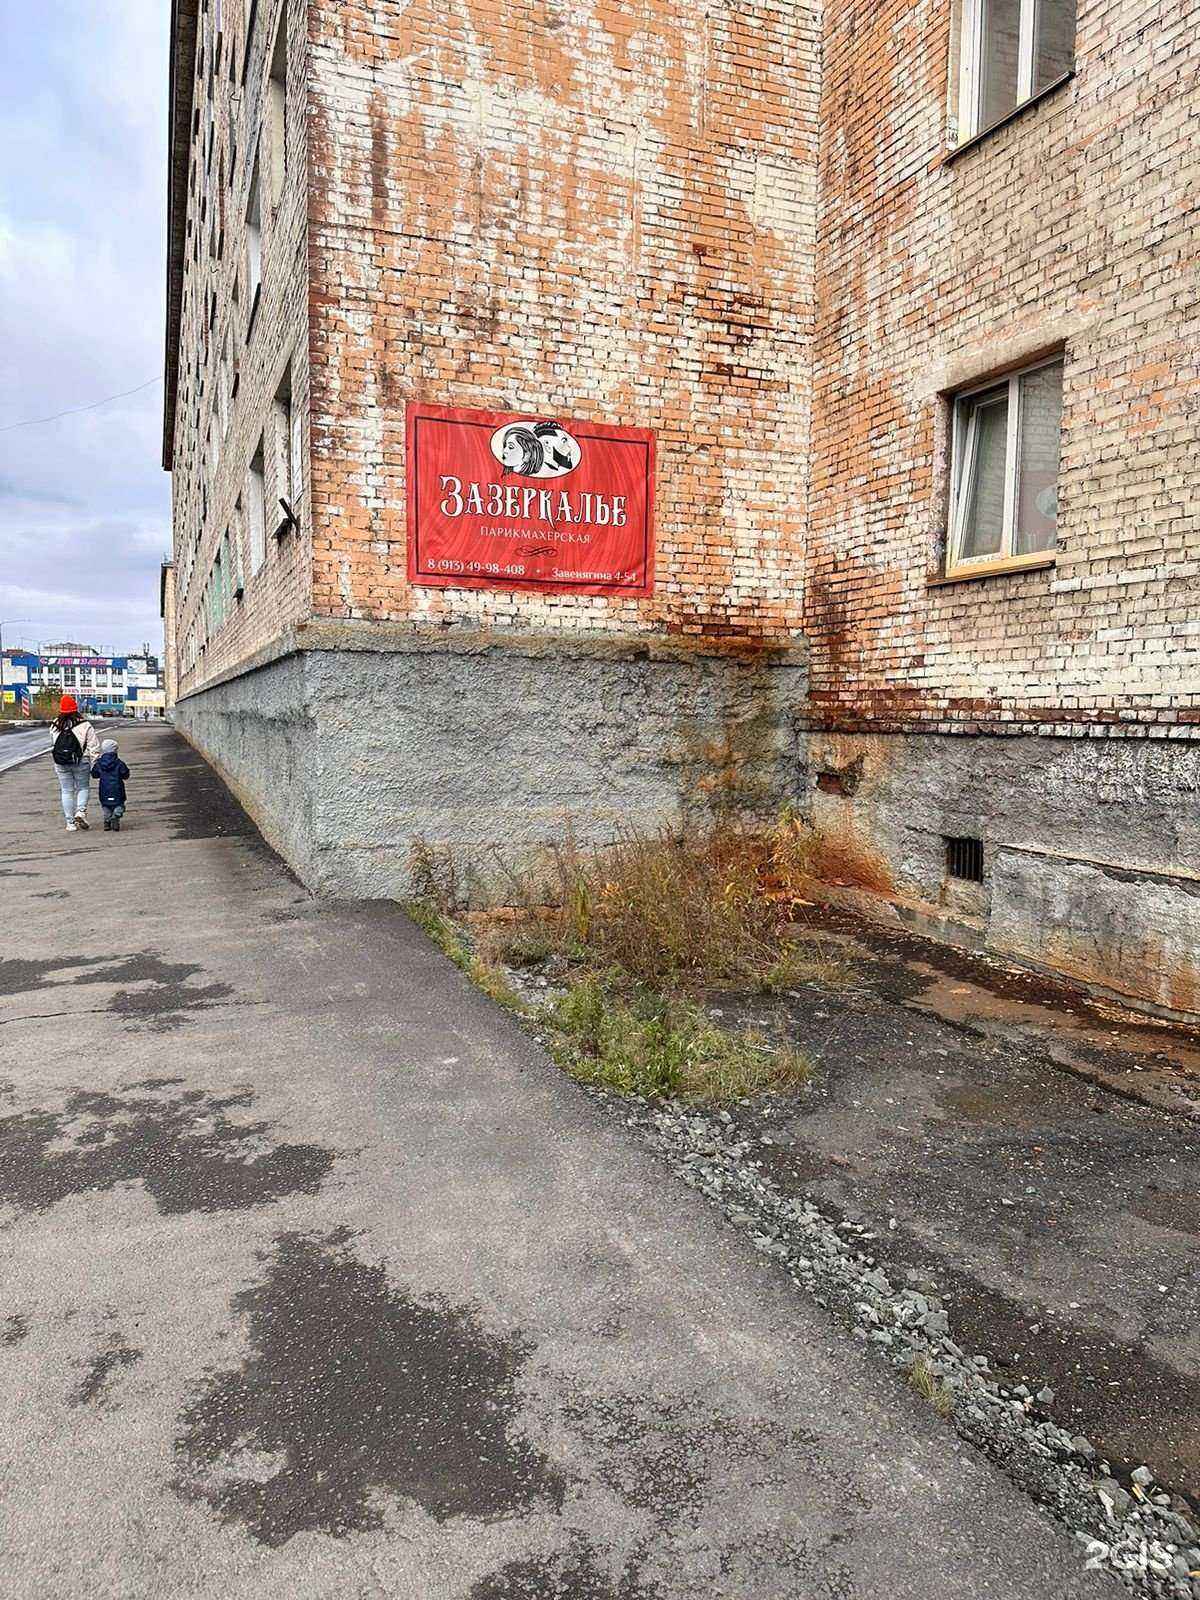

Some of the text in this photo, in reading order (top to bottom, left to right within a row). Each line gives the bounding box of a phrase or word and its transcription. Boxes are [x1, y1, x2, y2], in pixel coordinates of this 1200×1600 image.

[440, 475, 627, 529] ЗАЗЕРКАЛЬЕ
[480, 526, 591, 543] ПАРИКМАХЕРСКАЯ
[427, 559, 437, 569] 8
[438, 560, 465, 572] (913)
[466, 561, 525, 576] 49-98-408
[552, 567, 612, 580] Завенягина
